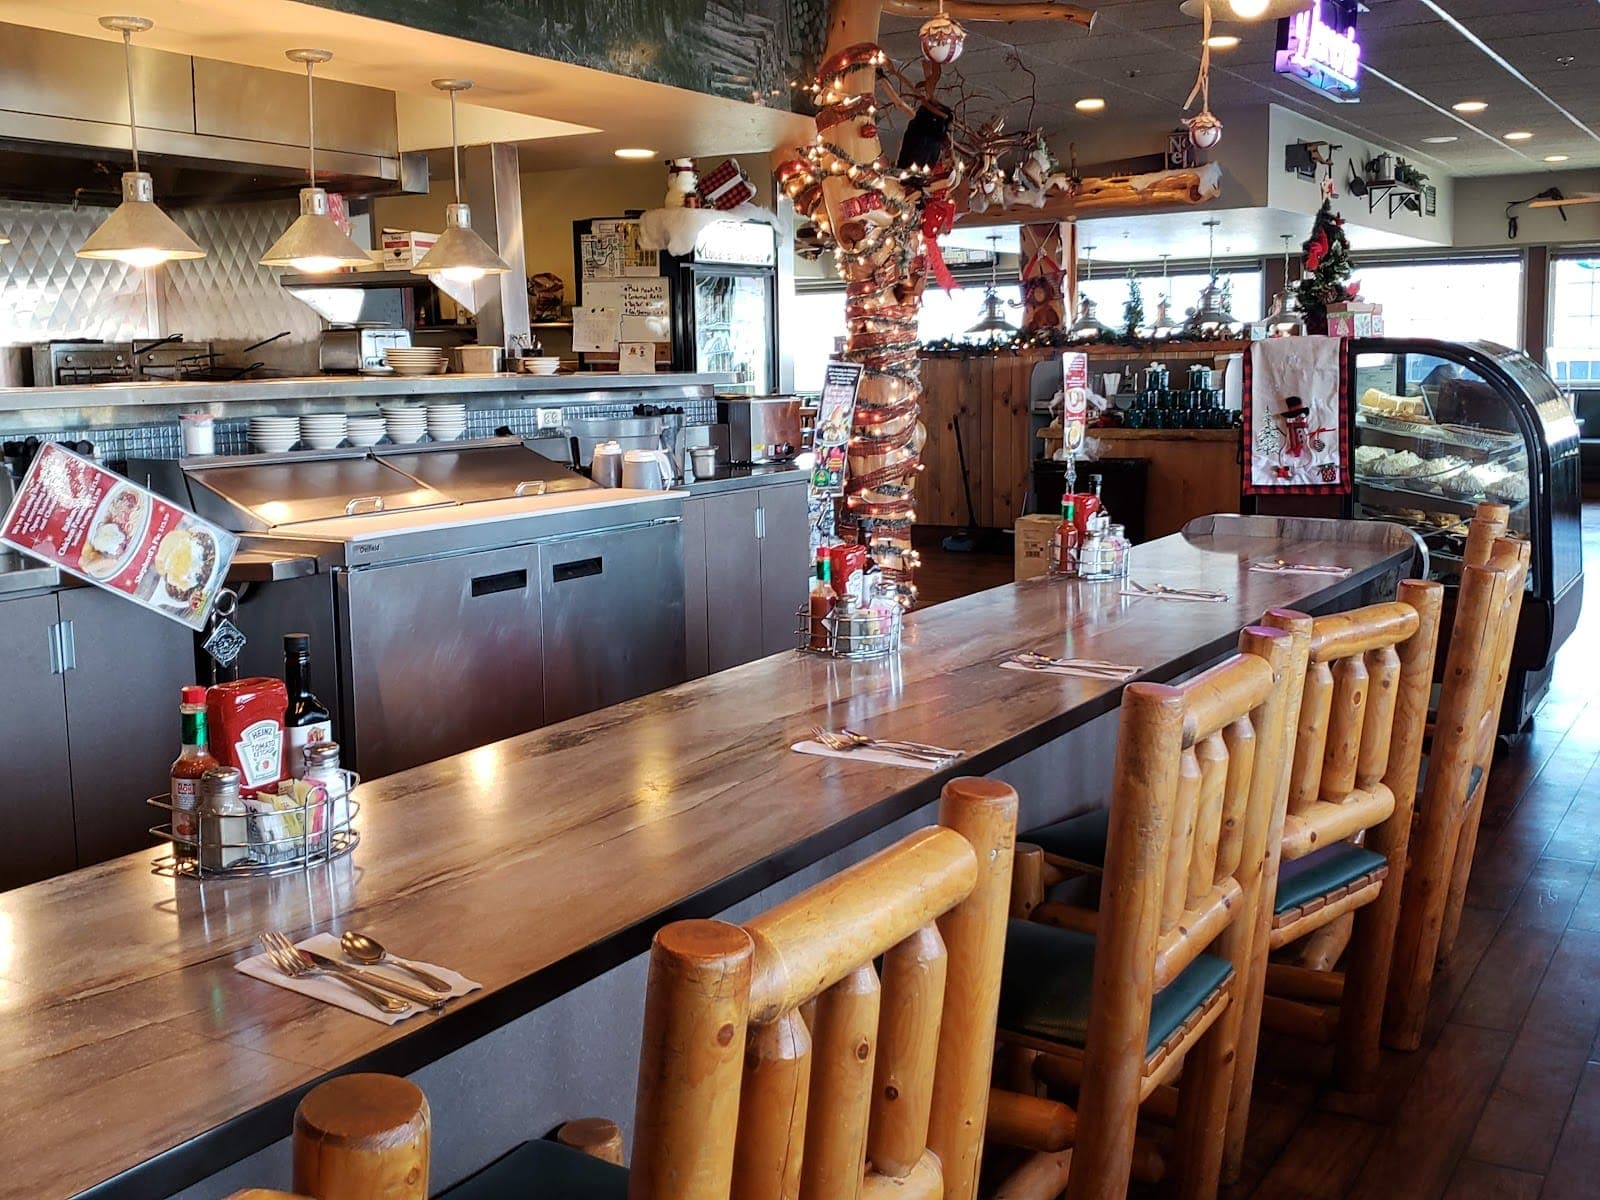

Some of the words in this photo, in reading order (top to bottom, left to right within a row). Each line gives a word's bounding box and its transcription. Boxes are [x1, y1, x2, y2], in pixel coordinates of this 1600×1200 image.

[57, 527, 75, 556] Chicken
[133, 544, 158, 585] Shepherd's
[151, 532, 161, 545] Pie
[252, 728, 273, 740] HEINZ
[252, 740, 276, 752] TOMATO
